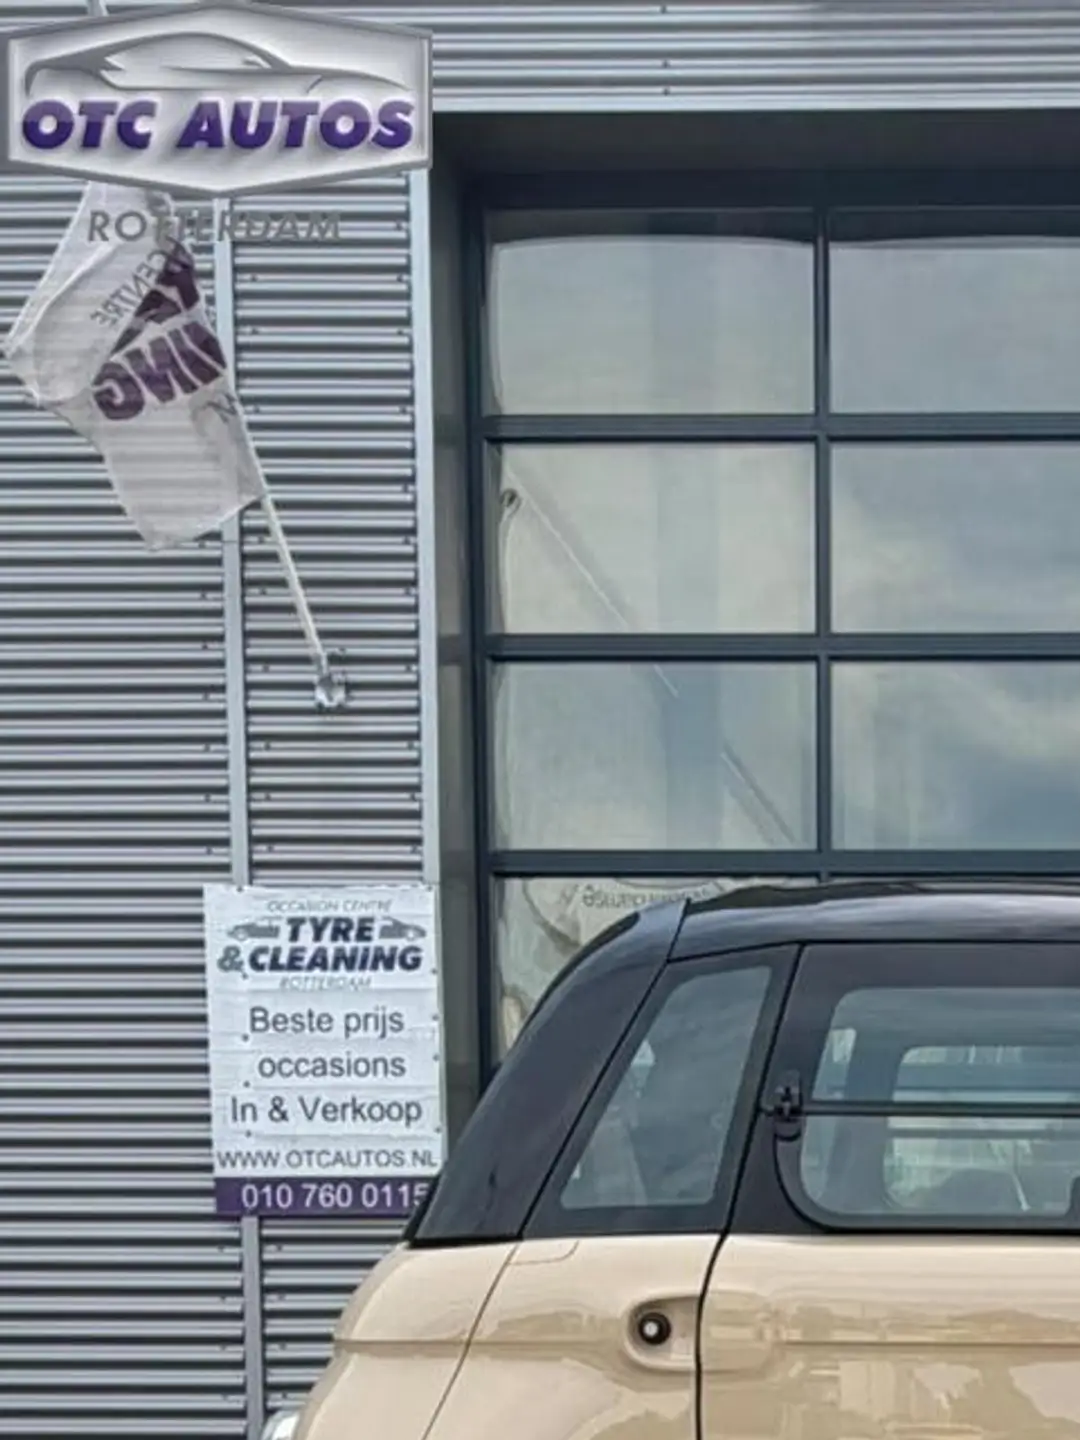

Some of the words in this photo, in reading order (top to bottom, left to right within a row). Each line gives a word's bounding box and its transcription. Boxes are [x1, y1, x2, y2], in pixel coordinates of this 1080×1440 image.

[286, 917, 375, 942] TYRE
[250, 1006, 333, 1033] Beste
[345, 1005, 404, 1039] prijs
[258, 1051, 406, 1077] occasions
[231, 1096, 257, 1122] In
[268, 1095, 289, 1122] &
[298, 1095, 422, 1127] Verkoop
[242, 1183, 292, 1208] 010
[301, 1183, 351, 1208] 760
